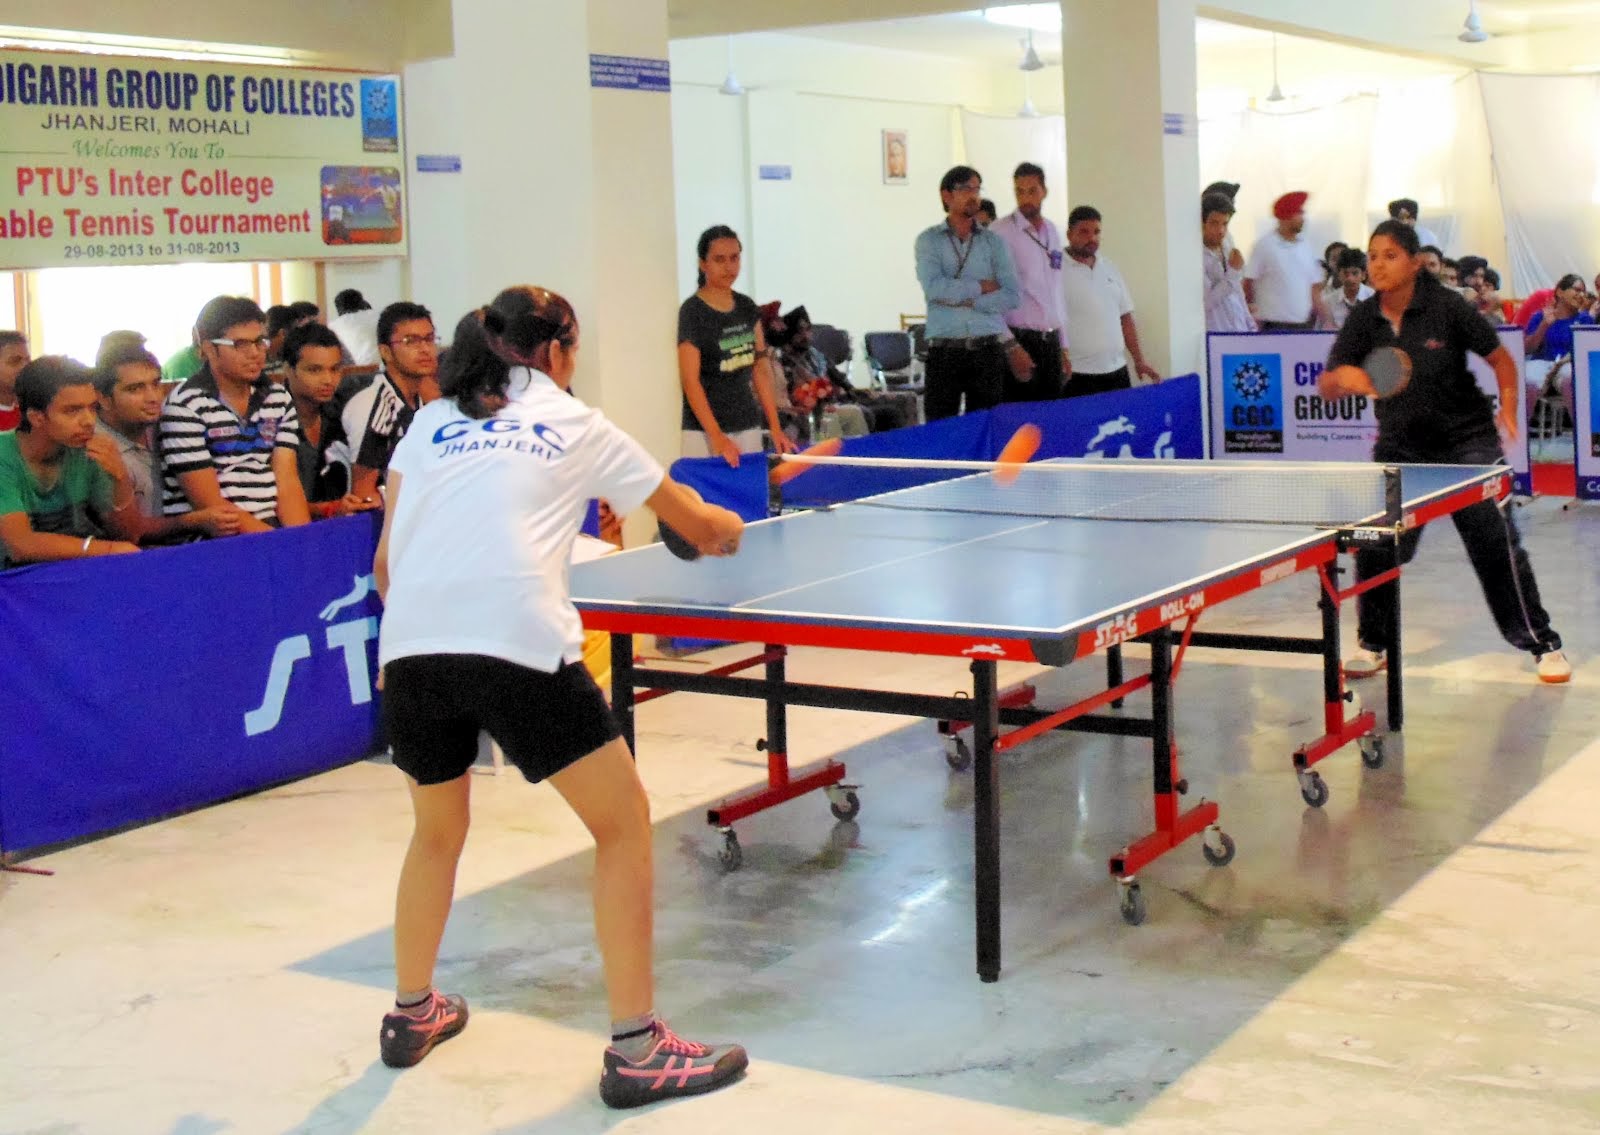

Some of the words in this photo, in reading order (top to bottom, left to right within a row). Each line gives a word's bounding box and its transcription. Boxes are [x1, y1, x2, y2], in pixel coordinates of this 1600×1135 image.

[0, 62, 98, 107] IGARH
[106, 68, 199, 112] GROUP
[205, 74, 236, 114] OF
[241, 76, 355, 118] COLLEGES
[41, 114, 161, 135] JHANJERI,
[169, 117, 250, 135] MOHALI
[72, 139, 160, 159] Welcomes
[168, 142, 198, 160] You
[203, 143, 225, 160] To
[16, 166, 99, 197] PTU's
[109, 168, 172, 197] Inter
[181, 168, 274, 203] College
[63, 208, 154, 237] Tennis
[163, 207, 311, 235] Tournament
[64, 244, 144, 258] 29-08-2013
[149, 245, 163, 256] to
[167, 242, 240, 256] 31-08-2013
[1232, 404, 1275, 427] CGC
[1294, 394, 1368, 421] GROUP
[432, 419, 564, 452] CGC
[439, 439, 551, 459] JHANJERI
[1160, 590, 1205, 622] ROLL-ON
